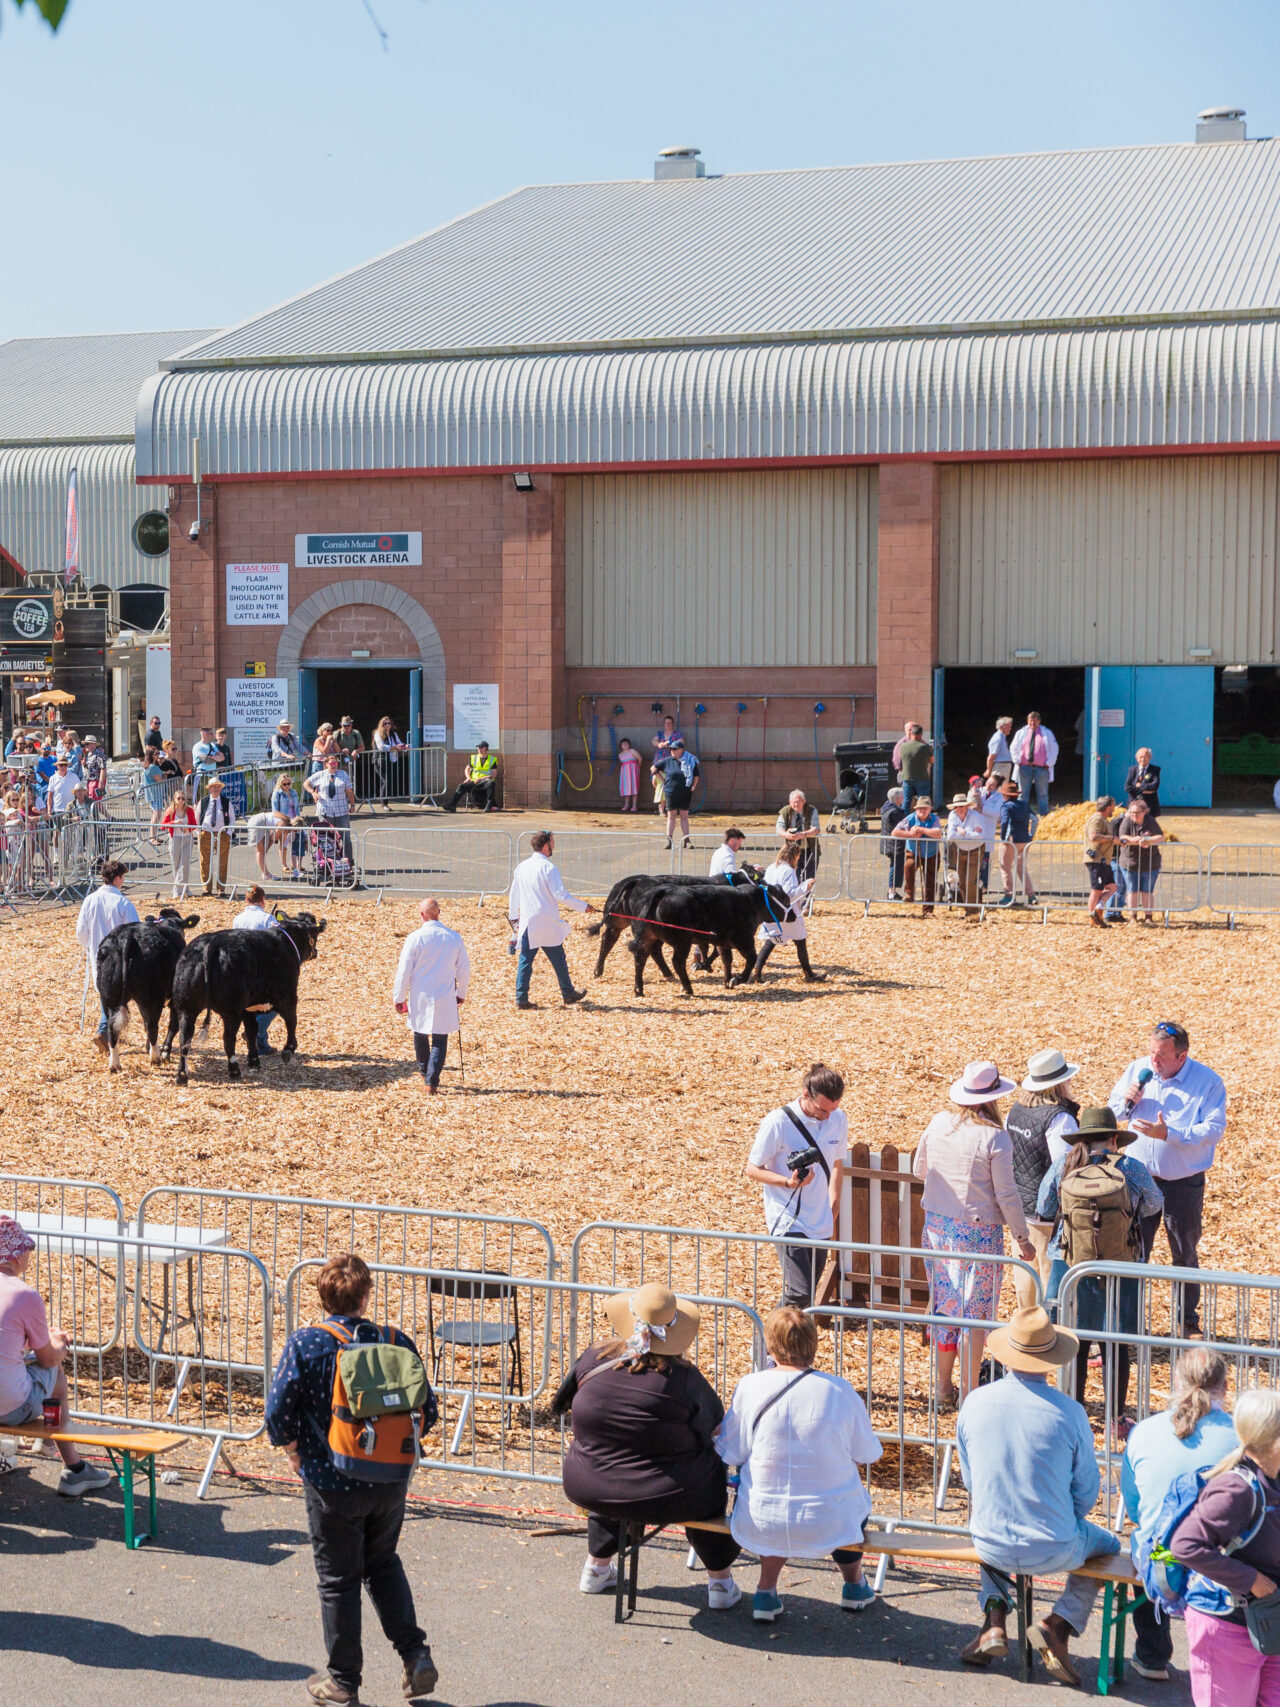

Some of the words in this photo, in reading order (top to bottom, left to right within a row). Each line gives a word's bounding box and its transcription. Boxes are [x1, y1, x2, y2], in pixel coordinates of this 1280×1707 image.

[322, 540, 350, 549] Cornish
[351, 539, 376, 548] Mutual
[307, 554, 366, 565] LIVESTOCK
[369, 553, 409, 563] ARENA
[12, 610, 49, 627] COFFEE
[23, 622, 35, 632] TEA
[13, 660, 45, 670] BAGUETTES
[239, 682, 275, 690] LIVESTOCK
